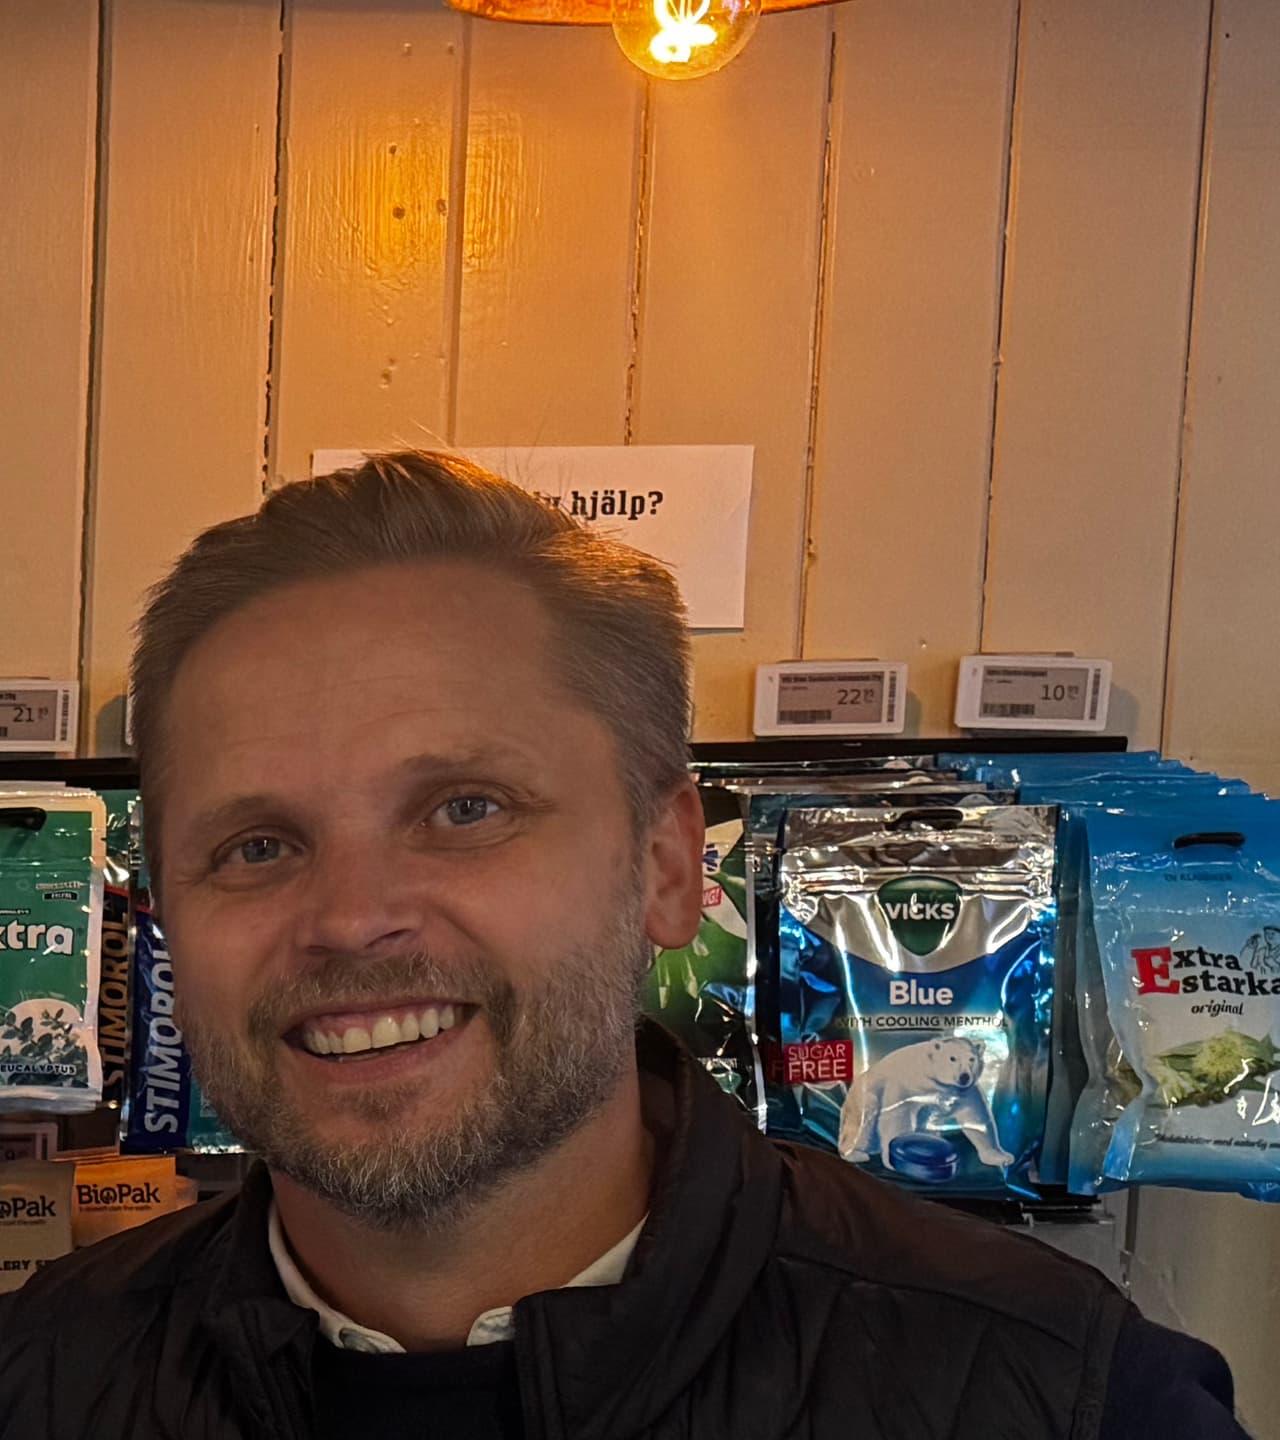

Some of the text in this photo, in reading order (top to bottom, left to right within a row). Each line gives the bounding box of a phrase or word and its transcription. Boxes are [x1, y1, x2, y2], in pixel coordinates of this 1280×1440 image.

[570, 490, 664, 521] hjälp?
[837, 689, 861, 705] 22
[1041, 684, 1065, 701] 10
[13, 707, 35, 723] 21
[885, 903, 955, 920] VICKS
[1131, 946, 1243, 995] Extra
[889, 979, 954, 1005] Blue
[102, 912, 129, 1098] STIMOROL
[1191, 999, 1245, 1018] original
[876, 1015, 940, 1027] COOLING
[944, 1016, 1009, 1028] MENTHOL
[788, 1043, 846, 1061] SUGAR
[0, 1063, 77, 1076] EUCALYPTUS
[788, 1059, 847, 1080] FREE
[76, 1182, 161, 1205] BioPak
